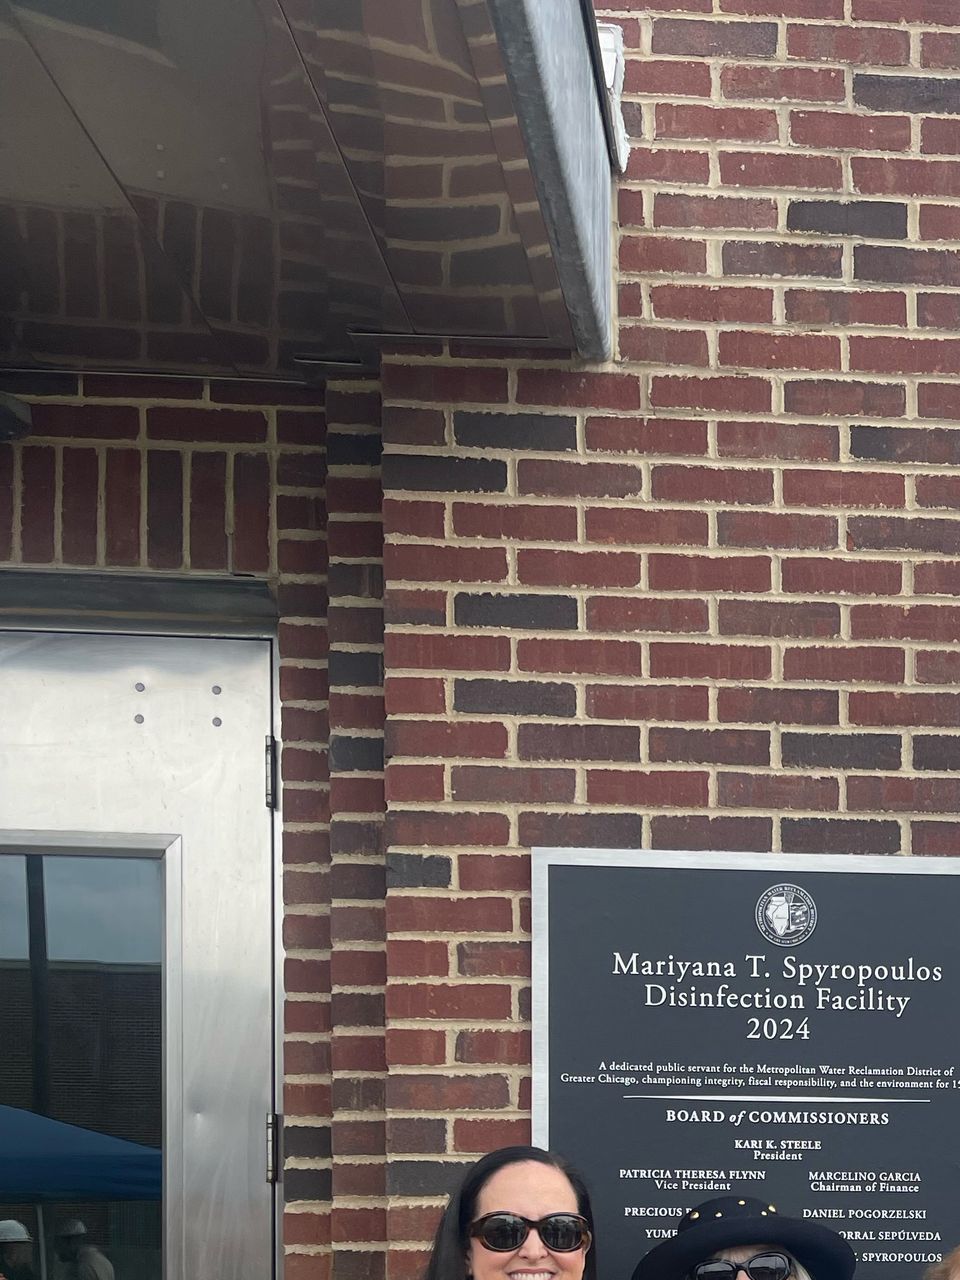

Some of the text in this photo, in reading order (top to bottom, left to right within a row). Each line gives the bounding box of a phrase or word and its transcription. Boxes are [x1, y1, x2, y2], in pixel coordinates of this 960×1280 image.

[612, 952, 942, 987] Mariyana T. Spyropoulos
[645, 984, 911, 1017] Disinfection Facility
[746, 1017, 810, 1039] 2024
[599, 1061, 955, 1076] A dedicated public servant for the Metropolitan Water Reclamation District of
[560, 1073, 595, 1082] Greater
[598, 1074, 639, 1086] Chicago,
[642, 1074, 702, 1087] championing
[704, 1076, 745, 1087] integrity,
[748, 1076, 772, 1086] fiscal
[775, 1077, 837, 1089] responsibility,
[840, 1078, 857, 1087] and
[859, 1078, 874, 1087] the
[876, 1079, 933, 1088] environment
[936, 1079, 949, 1088] for
[666, 1110, 889, 1126] BOARD of COMMISSIONERS
[734, 1139, 822, 1150] KARI K. STEELE
[753, 1150, 802, 1160] President
[619, 1169, 766, 1179] PATRICIA THERESA FLYNN
[809, 1171, 921, 1181] MARCELINO GARCIA
[654, 1179, 731, 1190] Vice President
[810, 1181, 919, 1192] Chairman of Finance
[624, 1207, 682, 1217] PRECIOUS
[803, 1209, 926, 1219] DANIEL POGORZELSKI
[878, 1229, 941, 1240] SEPÚLVEDA
[862, 1252, 942, 1262] SPYROPOULOS
